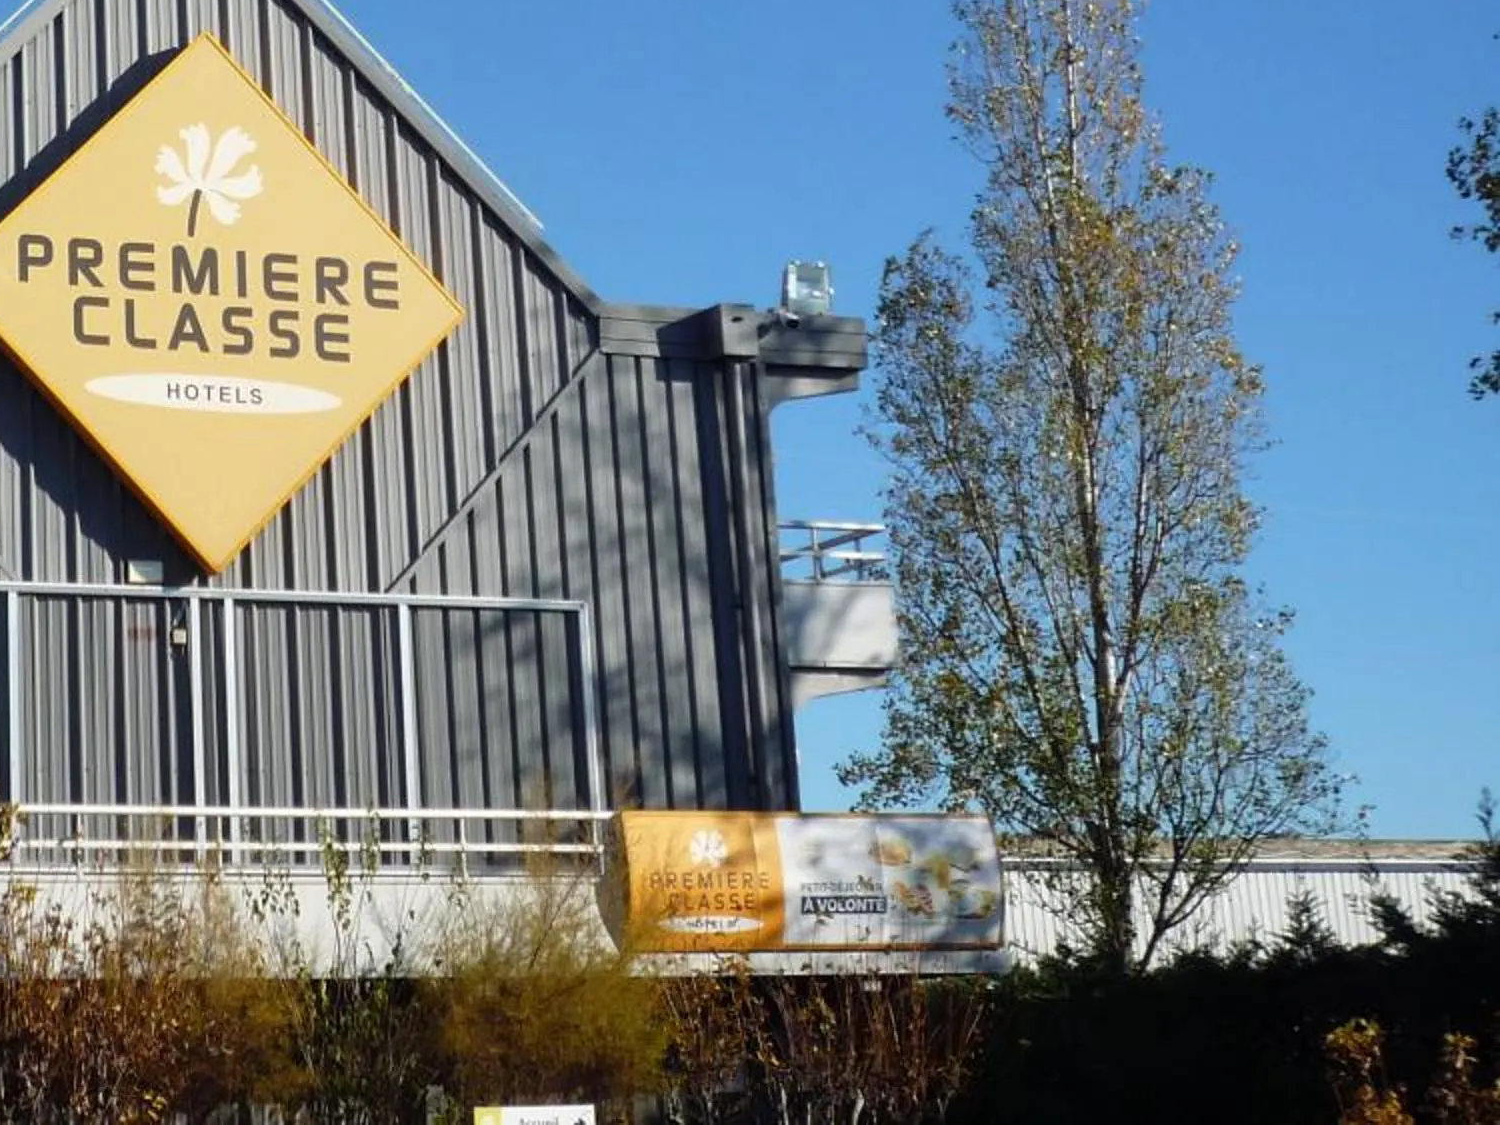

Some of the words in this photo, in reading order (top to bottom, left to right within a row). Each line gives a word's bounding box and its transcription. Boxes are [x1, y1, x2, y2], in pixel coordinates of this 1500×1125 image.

[18, 234, 399, 310] PREMIERE
[74, 296, 350, 362] CLASSE
[166, 383, 264, 406] HOTELS
[650, 871, 769, 889] PREMIERE
[667, 893, 756, 911] CLASSE
